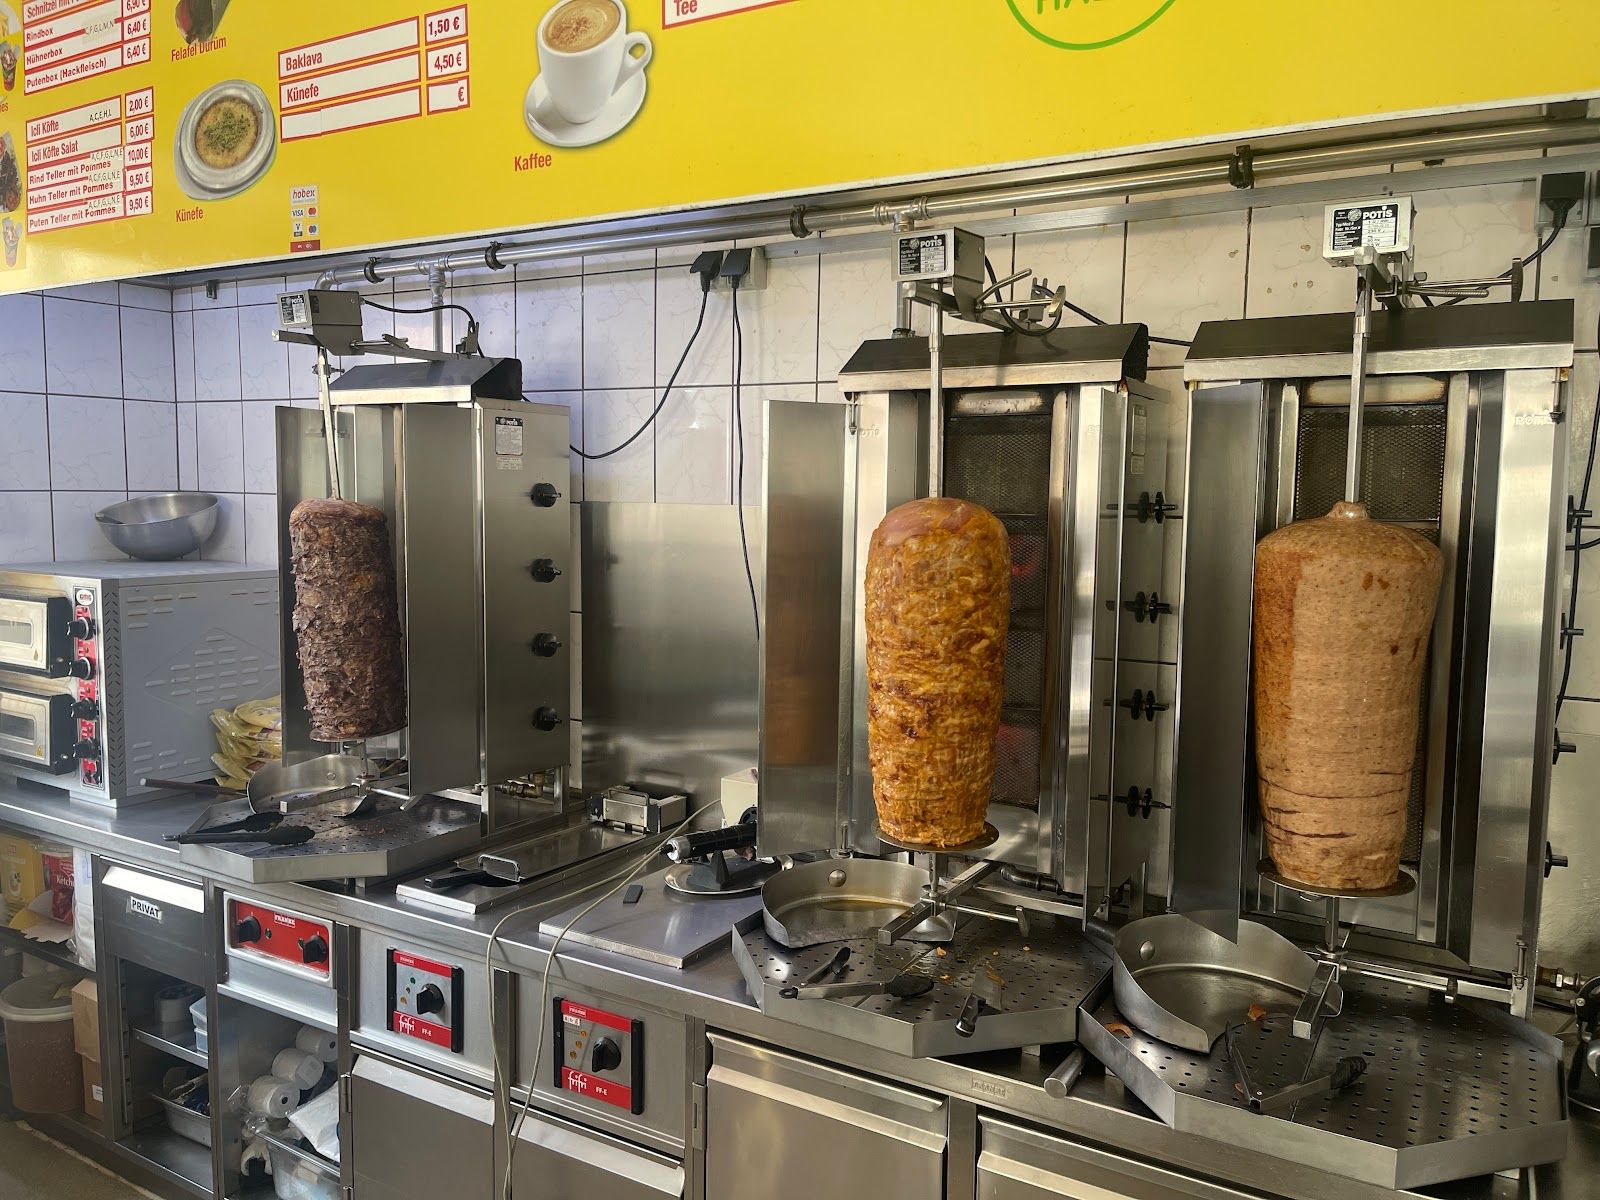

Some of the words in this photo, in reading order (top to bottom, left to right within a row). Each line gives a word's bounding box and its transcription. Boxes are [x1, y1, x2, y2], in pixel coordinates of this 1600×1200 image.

[673, 0, 698, 16] Tee
[26, 27, 54, 42] Rindbox
[127, 21, 141, 35] 6,40
[142, 19, 147, 31] €
[428, 18, 450, 37] 1,50
[452, 16, 460, 31] €
[26, 47, 63, 66] Hühnerbox
[126, 45, 141, 60] 6,40
[141, 43, 146, 55] €
[285, 52, 323, 71] Baklava
[434, 53, 454, 73] 4,50
[456, 52, 462, 67] €
[26, 73, 58, 88] Putenbox
[60, 57, 107, 81] (Hackfleisch)
[286, 83, 319, 103] Künefe
[457, 86, 465, 102] €
[129, 99, 143, 113] 2,00
[144, 96, 149, 108] €
[42, 120, 59, 135] Köfte
[129, 124, 143, 140] 6,00
[144, 123, 149, 135] €
[42, 145, 60, 160] Köfte
[61, 140, 78, 154] Salat
[127, 148, 143, 164] 10,00
[144, 147, 149, 159] €
[514, 152, 552, 172] Kaffee
[29, 174, 45, 185] Rind
[46, 170, 66, 181] Teller
[67, 166, 79, 177] mit
[80, 160, 112, 174] Pommes
[129, 173, 144, 188] 9,50
[145, 171, 149, 183] €
[29, 193, 47, 205] Huhn
[48, 189, 67, 201] Teller
[69, 185, 81, 197] mit
[82, 181, 114, 195] Pommes
[292, 188, 315, 199] hobex
[129, 197, 143, 212] 9,50
[144, 195, 149, 208] €
[29, 217, 49, 228] Puten
[50, 214, 70, 225] Teller
[71, 209, 84, 221] mit
[85, 205, 116, 218] Pommes
[175, 206, 204, 222] Künefe
[292, 209, 304, 217] VISA
[132, 899, 159, 918] PRIVAT
[567, 1070, 588, 1093] frifri
[595, 1086, 608, 1096] FF-E
